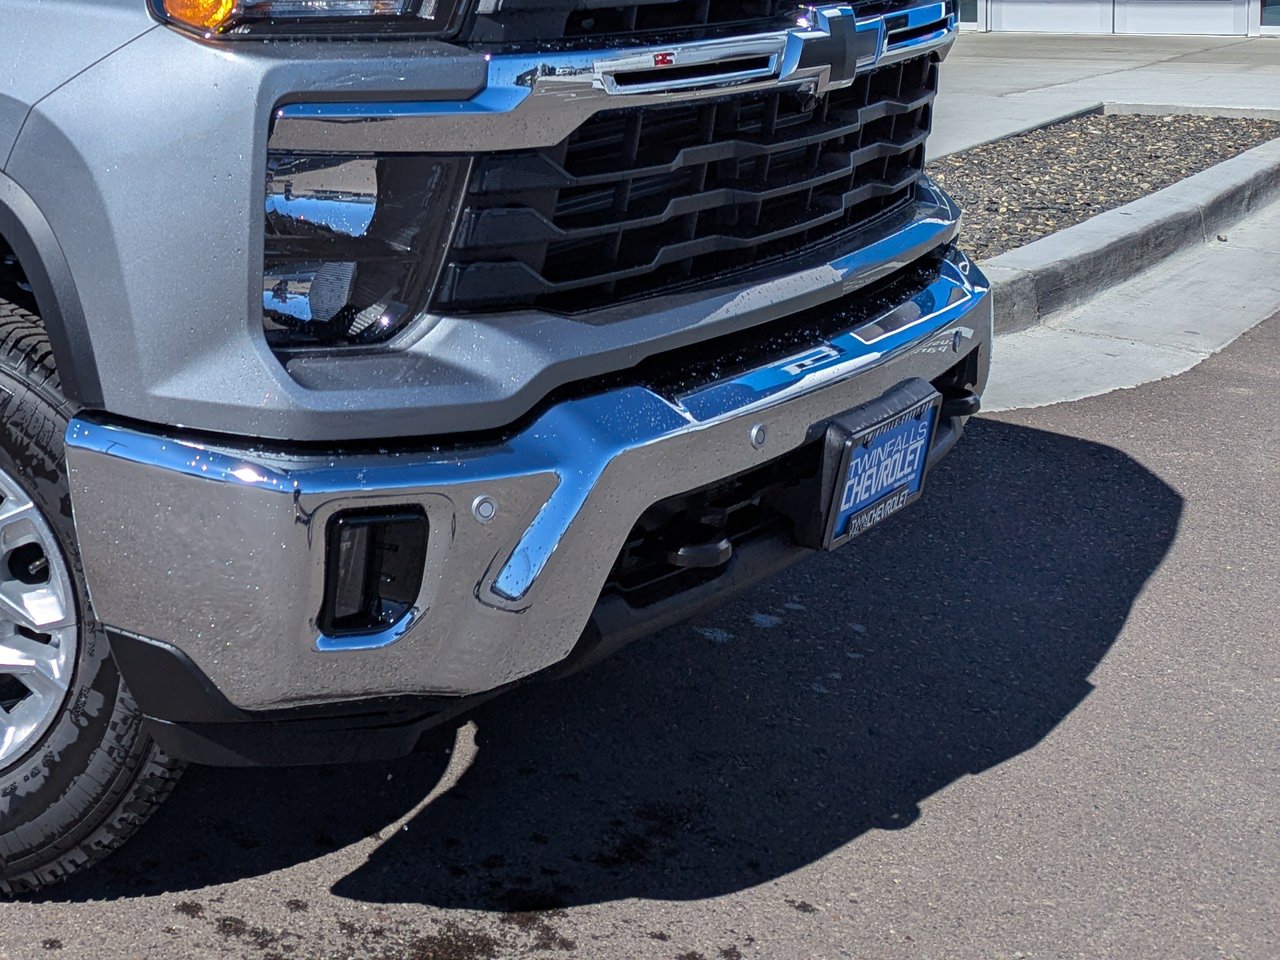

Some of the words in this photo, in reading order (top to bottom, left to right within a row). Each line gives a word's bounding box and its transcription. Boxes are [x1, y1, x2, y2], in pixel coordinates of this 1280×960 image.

[840, 439, 925, 512] CHEVROLET
[849, 421, 928, 479] TWINFALLS
[867, 489, 910, 528] CHEVROLET
